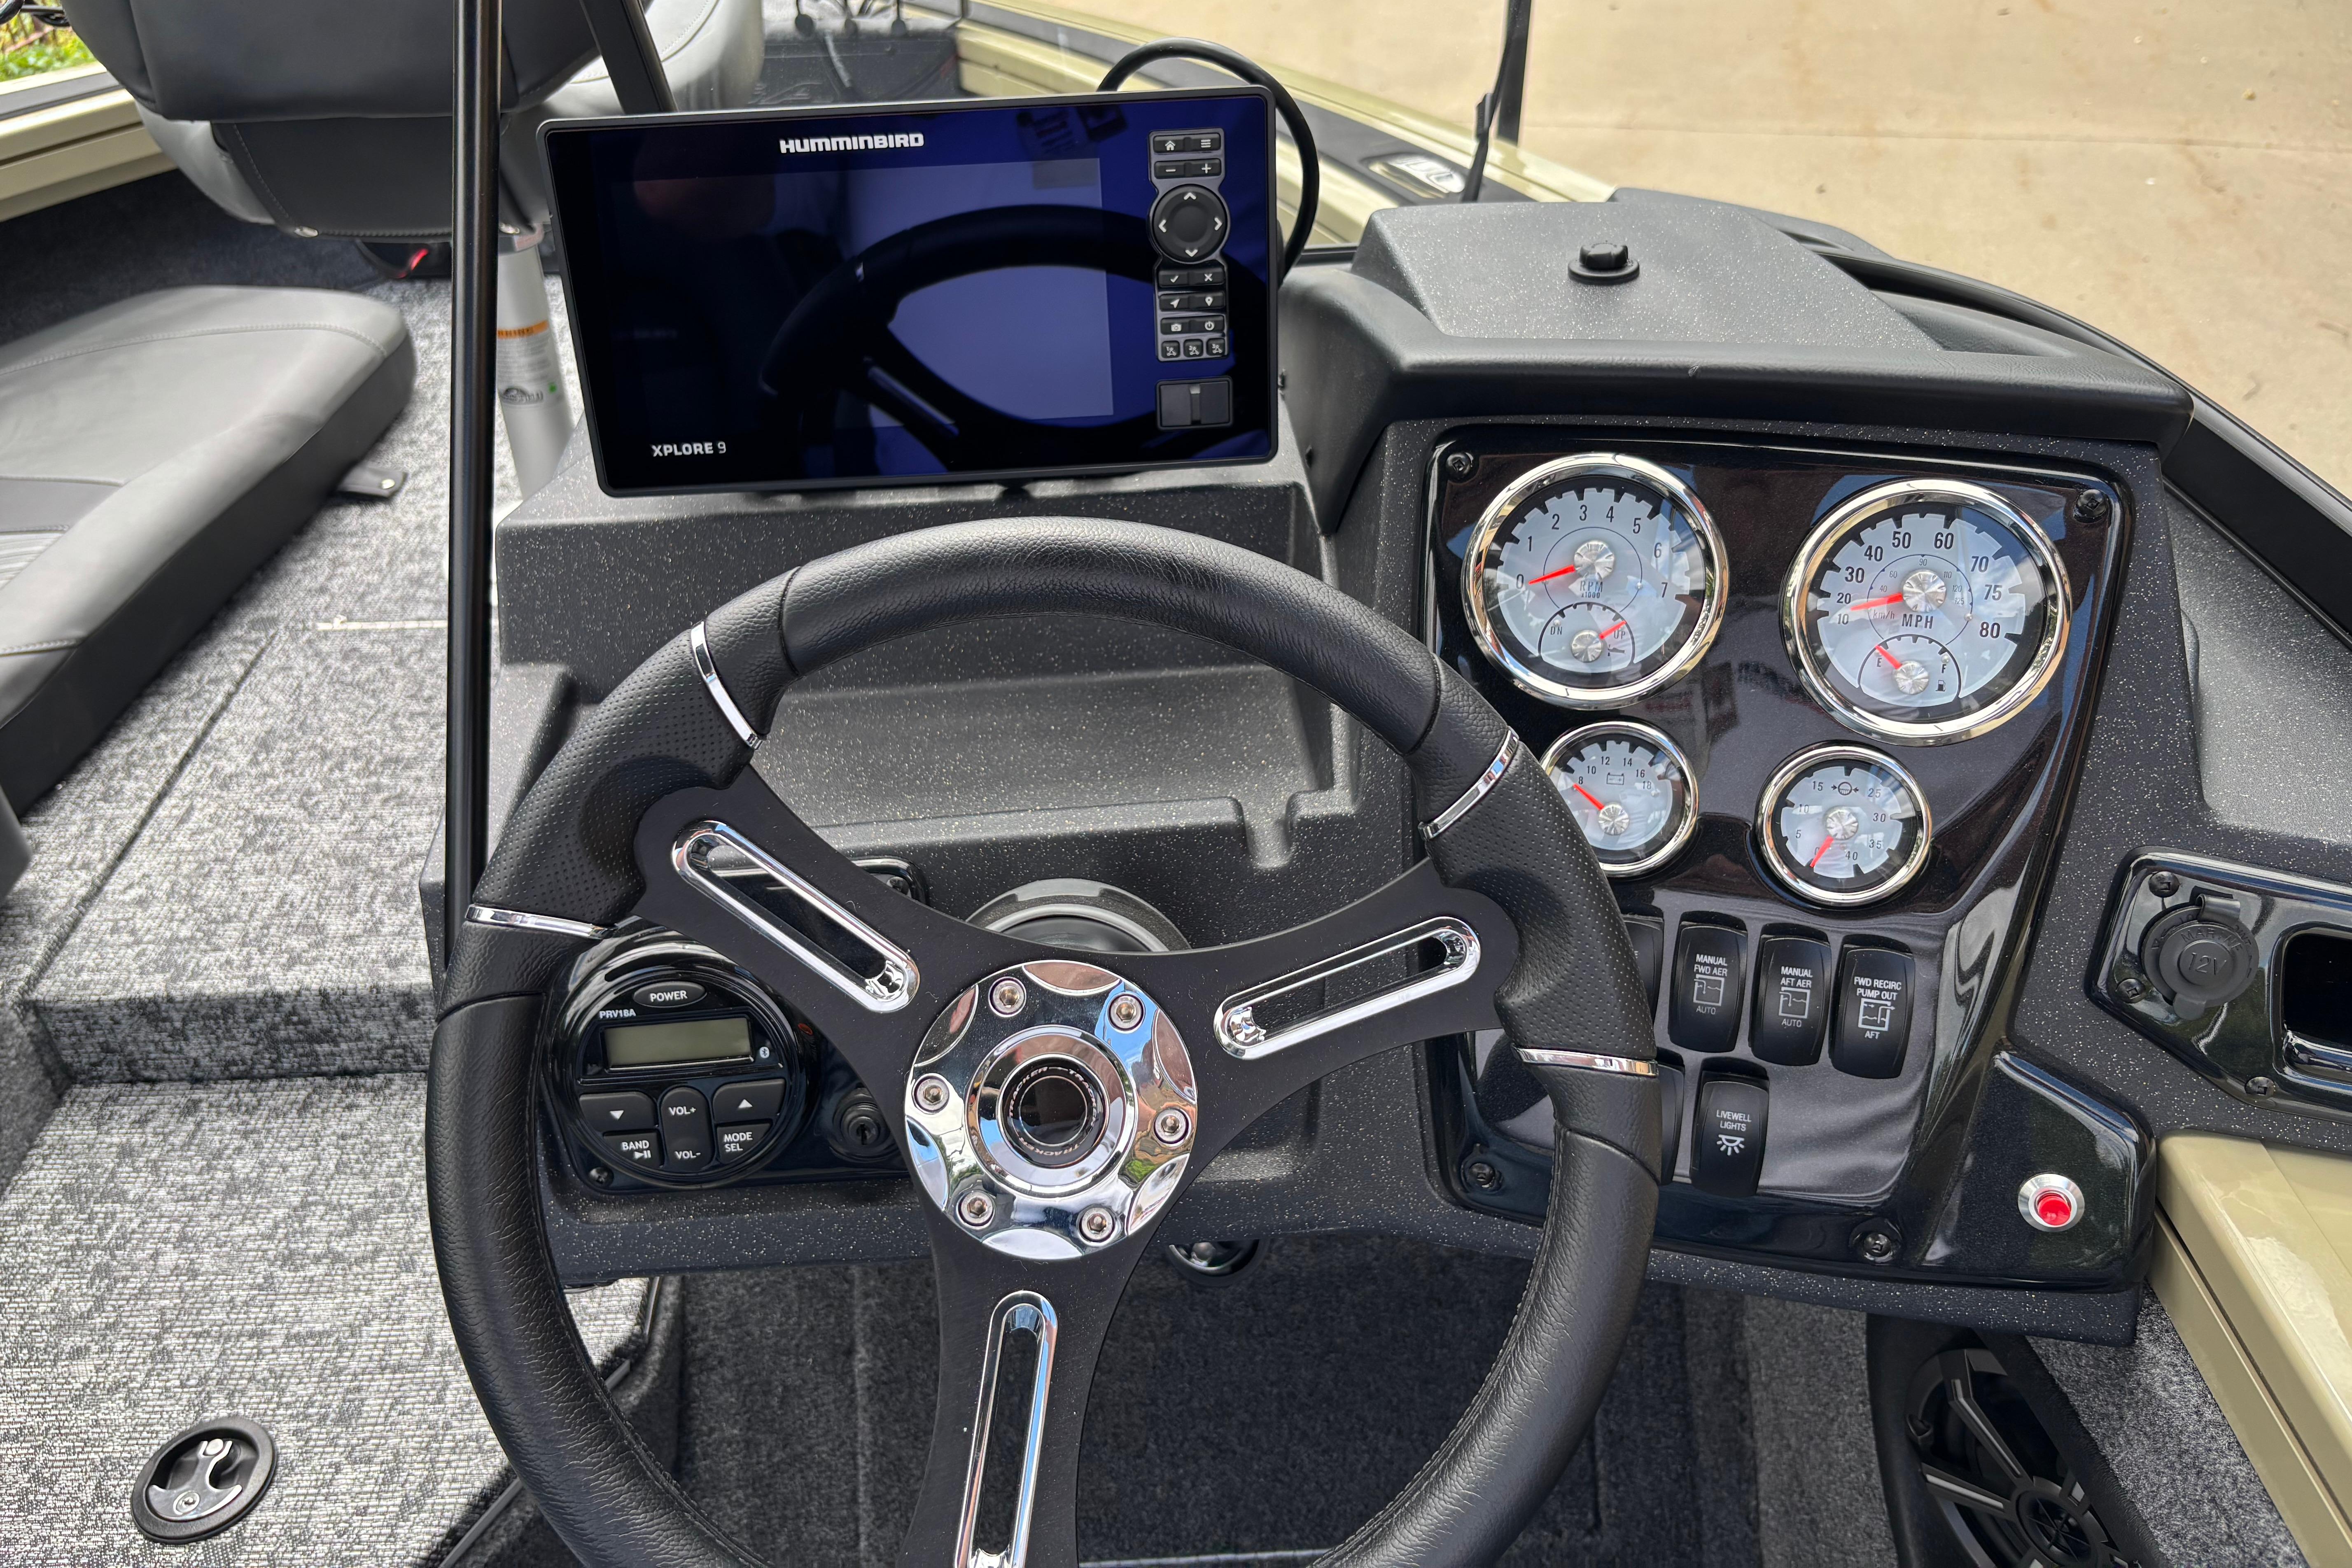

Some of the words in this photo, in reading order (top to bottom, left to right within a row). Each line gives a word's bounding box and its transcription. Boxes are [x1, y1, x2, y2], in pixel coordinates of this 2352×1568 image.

[780, 133, 924, 153] HUMMINBIRD
[651, 442, 714, 457] XPLORE
[718, 441, 726, 454] 9
[1580, 505, 1587, 521] 3
[1606, 506, 1614, 523] 4
[1552, 514, 1560, 530] 2
[1633, 518, 1641, 534] 5
[1528, 536, 1533, 551] 1
[1892, 531, 1911, 549] 50
[1934, 532, 1954, 550] 60
[1654, 543, 1662, 558] 6
[1864, 545, 1883, 562] 40
[1970, 555, 1989, 573] 70
[1844, 567, 1865, 584] 30
[1516, 575, 1524, 589] 0
[1580, 580, 1603, 593] RPM
[1661, 582, 1668, 597] 7
[1984, 584, 2002, 601] 75
[1836, 593, 1851, 605] 20
[1837, 614, 1849, 625] 10
[1872, 609, 1895, 620] km/h
[1902, 614, 1934, 629] MPH
[1550, 626, 1562, 636] DN
[1614, 629, 1626, 639] UP
[1979, 621, 2000, 639] 80
[1876, 658, 1881, 667] E
[1941, 664, 1946, 674] F
[1601, 756, 1610, 765] 12
[1623, 758, 1632, 767] 14
[1587, 765, 1596, 774] 10
[1579, 776, 1583, 784] 8
[1643, 781, 1651, 789] 18
[1813, 781, 1823, 791] 15
[1868, 789, 1881, 798] 25
[1799, 805, 1809, 813] 10
[1873, 813, 1885, 822] 30
[1796, 830, 1801, 838] 5
[1869, 840, 1882, 849] 35
[1845, 851, 1858, 860] 40
[1696, 954, 1727, 966] MANUAL
[2189, 952, 2227, 975] 12V
[1694, 965, 1711, 974] FWD
[1712, 967, 1727, 976] AER
[1781, 966, 1813, 978] MANUAL
[1780, 977, 1795, 986] AFT
[1796, 979, 1812, 988] AER
[1854, 977, 1871, 987] FWD
[1873, 979, 1902, 990] RECIRC
[649, 990, 688, 1002] POWER
[1856, 988, 1880, 999] PUMP
[1881, 991, 1897, 1001] OUT
[599, 1009, 636, 1019] PRV18A
[1696, 1006, 1716, 1015] AUTO
[1781, 1018, 1802, 1027] AUTO
[1864, 1031, 1880, 1039] AFT
[1009, 1066, 1048, 1116] TRACKER
[1069, 1069, 1097, 1127] TRACKER
[669, 1106, 696, 1115] VOL+
[1716, 1109, 1752, 1123] LIVEWELL
[1720, 1121, 1746, 1131] LIGHTS
[724, 1132, 753, 1142] MODE
[622, 1140, 649, 1150] BAND
[725, 1143, 743, 1152] SEL
[1019, 1137, 1080, 1155] TRACKER
[675, 1151, 701, 1159] VOL-
